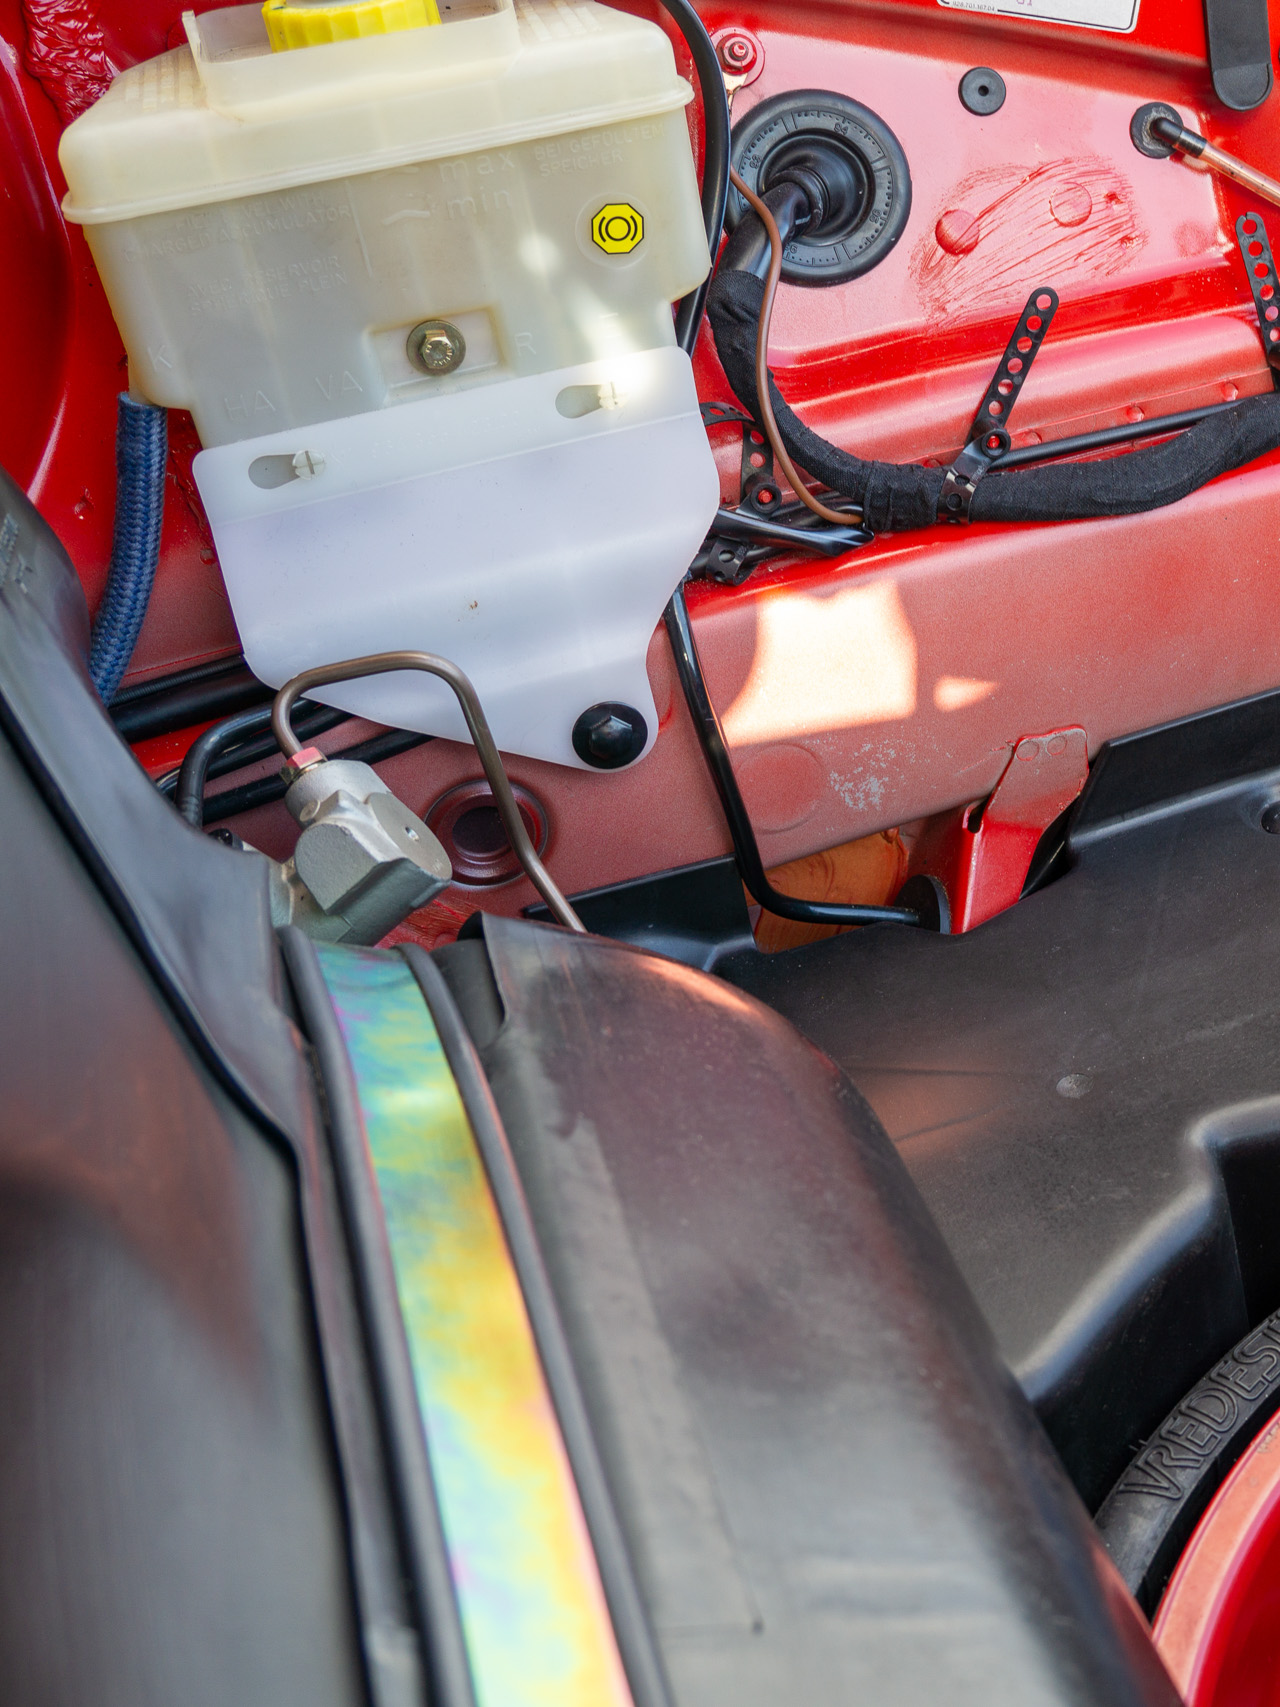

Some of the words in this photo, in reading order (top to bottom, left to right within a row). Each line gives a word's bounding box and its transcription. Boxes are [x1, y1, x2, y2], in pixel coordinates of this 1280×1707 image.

[439, 149, 517, 183] max
[538, 149, 623, 176] SPEICHER
[447, 186, 514, 220] min
[146, 343, 172, 373] K
[514, 332, 538, 360] R
[314, 369, 364, 403] VA
[225, 389, 277, 424] HA
